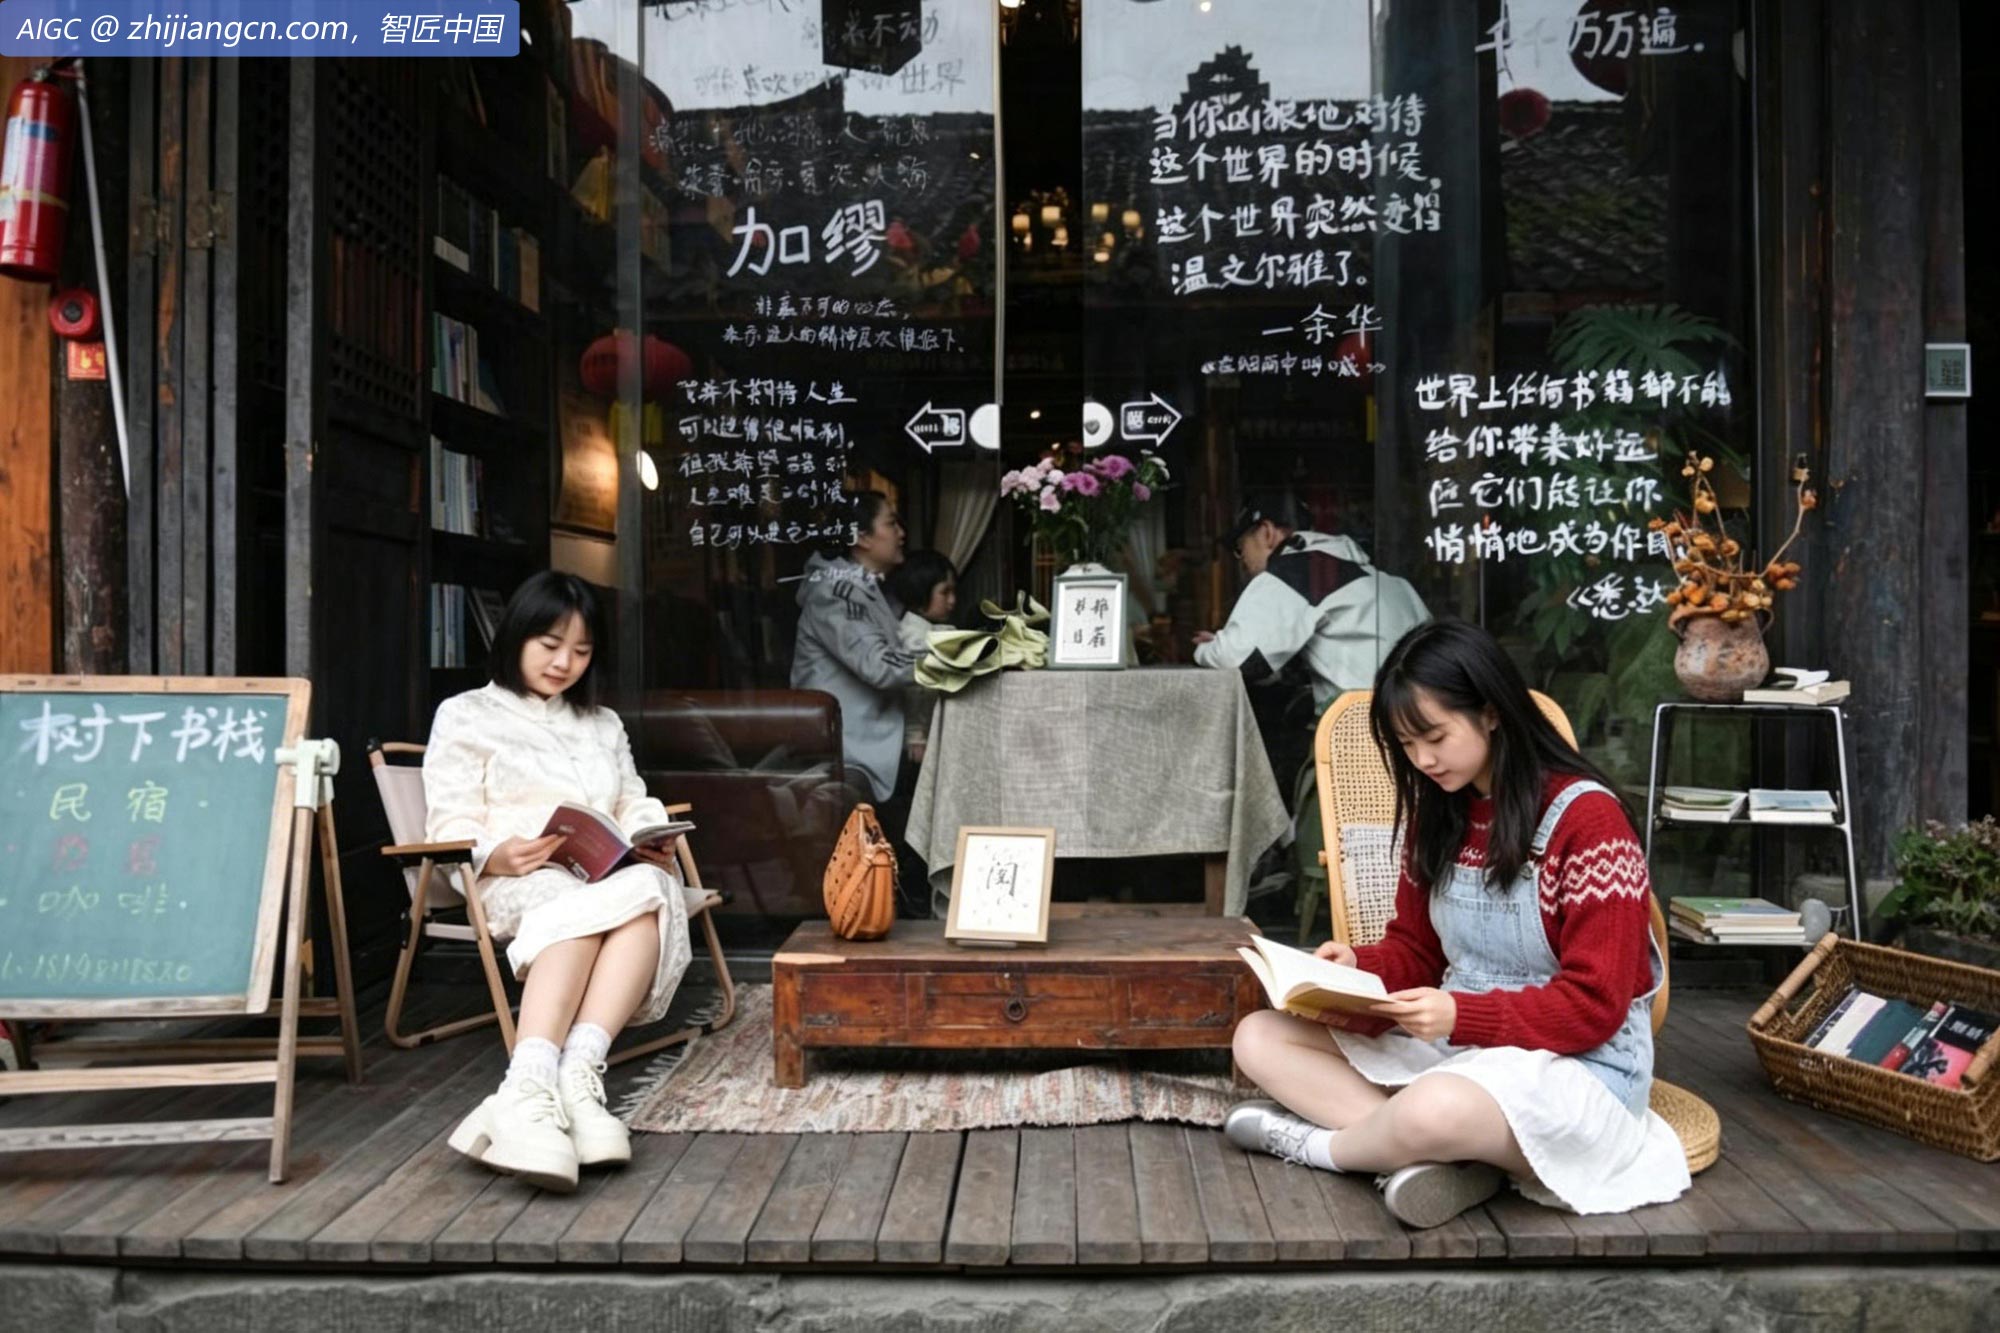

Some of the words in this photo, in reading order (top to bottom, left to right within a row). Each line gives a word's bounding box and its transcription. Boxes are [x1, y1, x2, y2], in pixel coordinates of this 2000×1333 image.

[1150, 92, 1429, 142] 当你凶狠地对待
[726, 199, 887, 278] 加缪
[1155, 191, 1441, 244] 这个世界突然变得
[1415, 368, 1732, 419] 世界上任何书籍都不能
[1424, 421, 1658, 467] 给你带来好运
[1424, 519, 1688, 564] 悄悄地成为你自
[20, 700, 268, 765] 树下书栈
